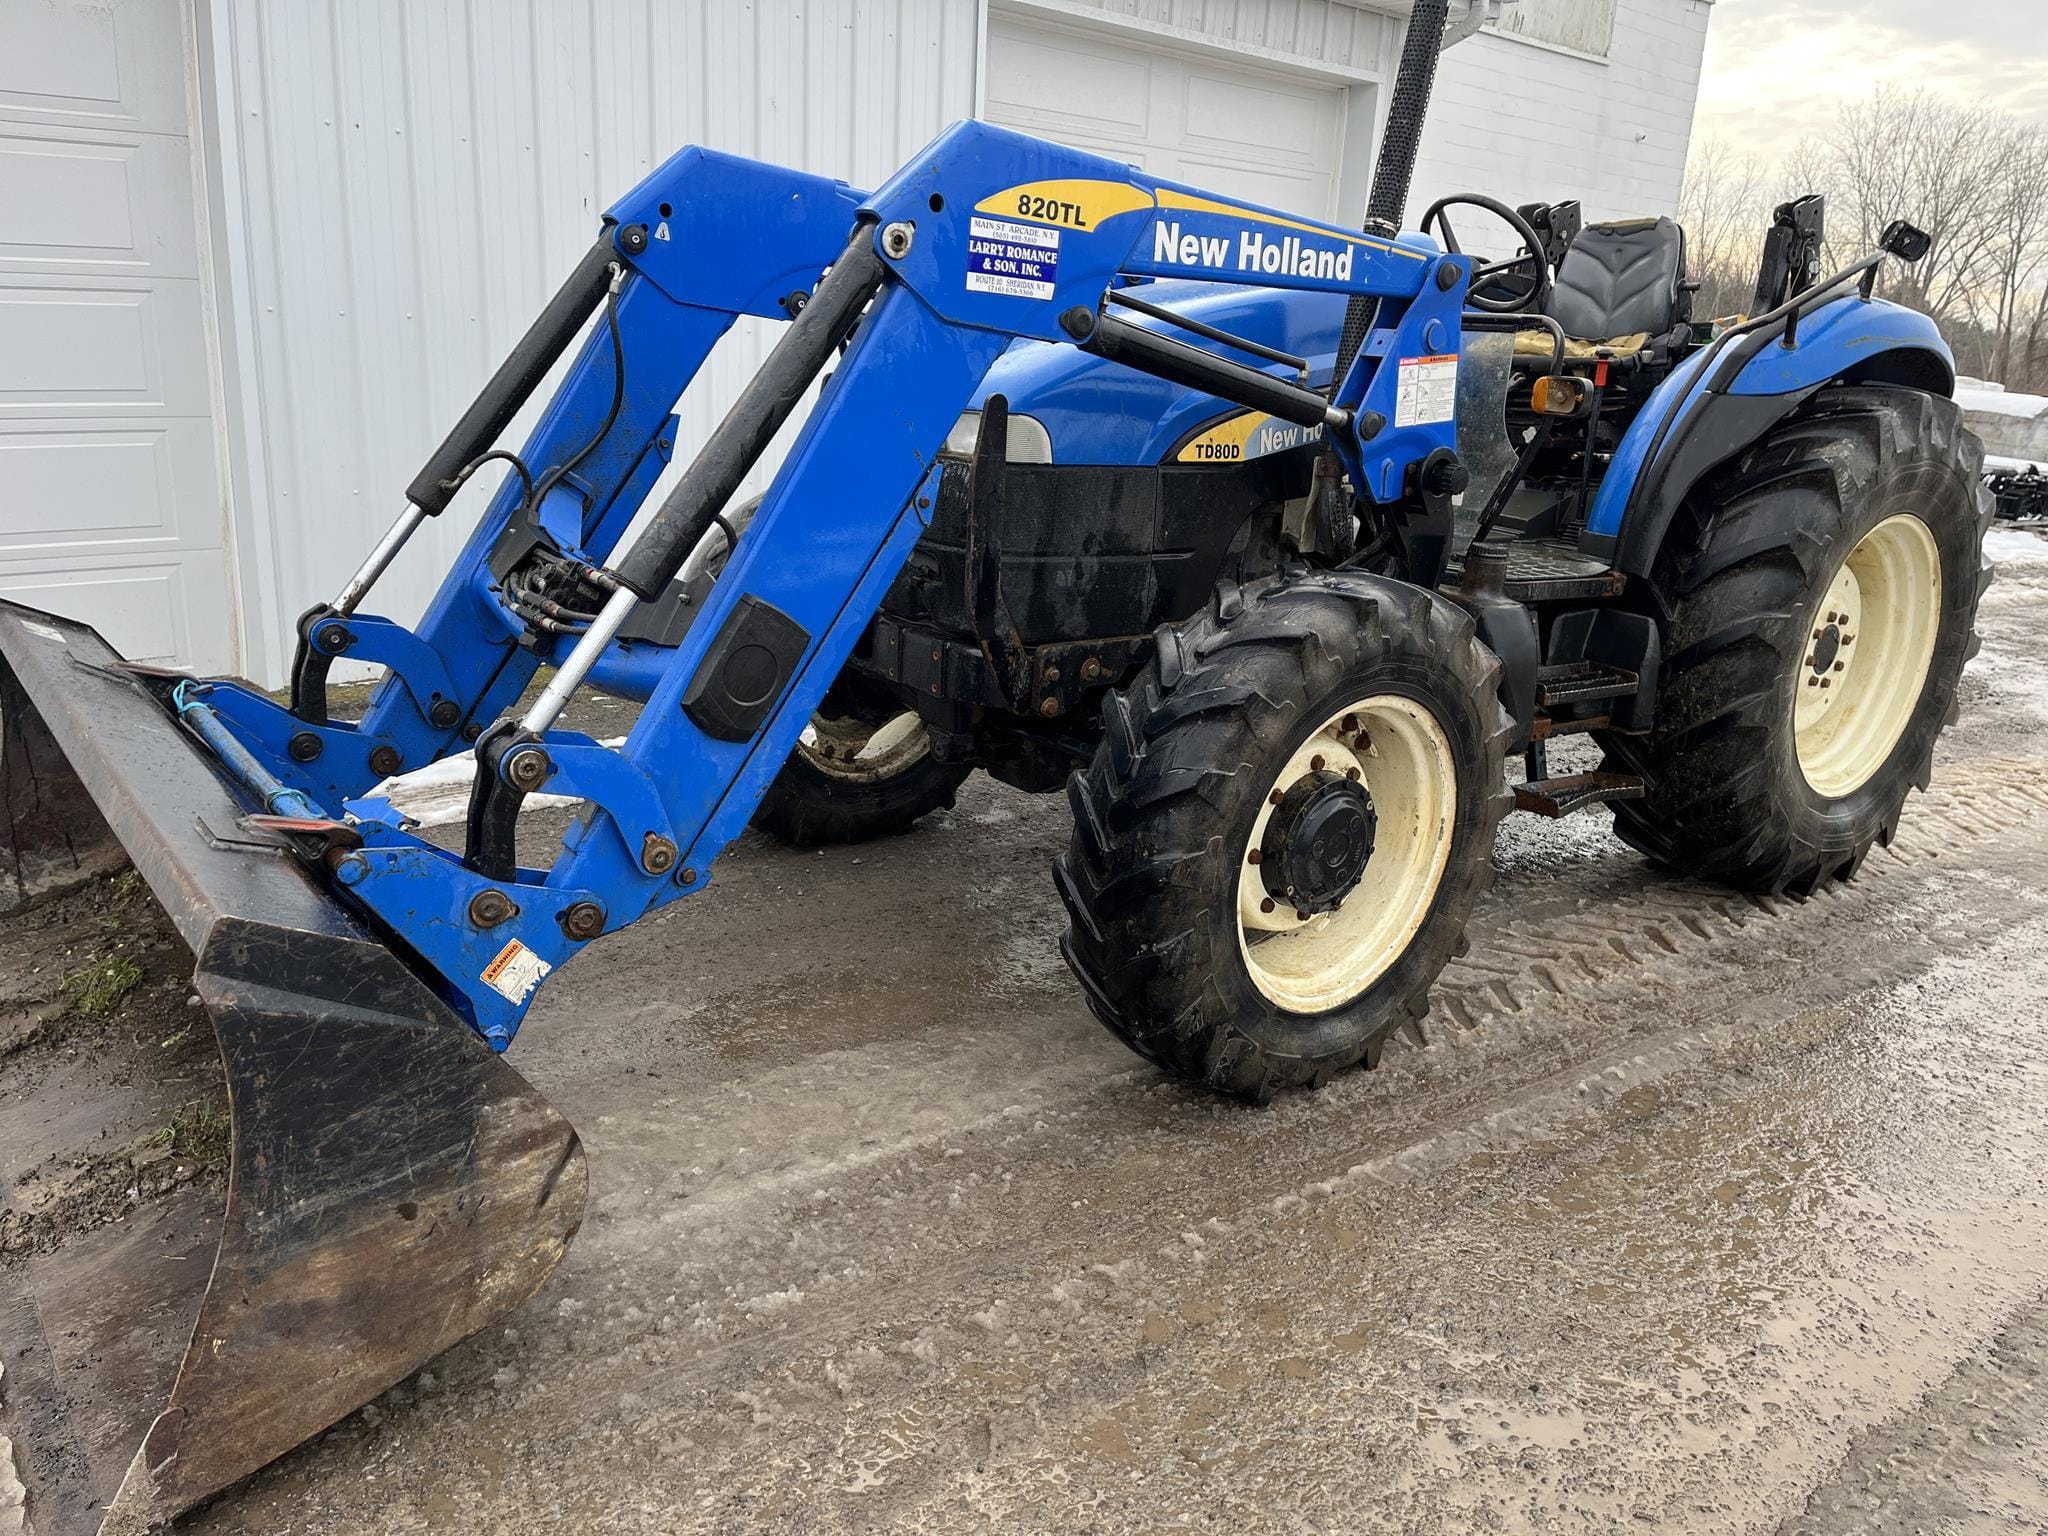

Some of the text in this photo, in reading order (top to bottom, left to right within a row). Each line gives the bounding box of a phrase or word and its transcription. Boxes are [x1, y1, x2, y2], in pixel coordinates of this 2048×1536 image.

[1018, 194, 1086, 226] 820TL
[974, 219, 994, 229] MAIN
[969, 240, 1058, 265] LARRY ROMANCE
[1154, 220, 1354, 281] New Holland
[983, 258, 991, 270] &
[1021, 263, 1042, 277] INC.
[1195, 444, 1240, 459] TD80D
[1260, 427, 1298, 455] New
[491, 944, 518, 974] WARNING
